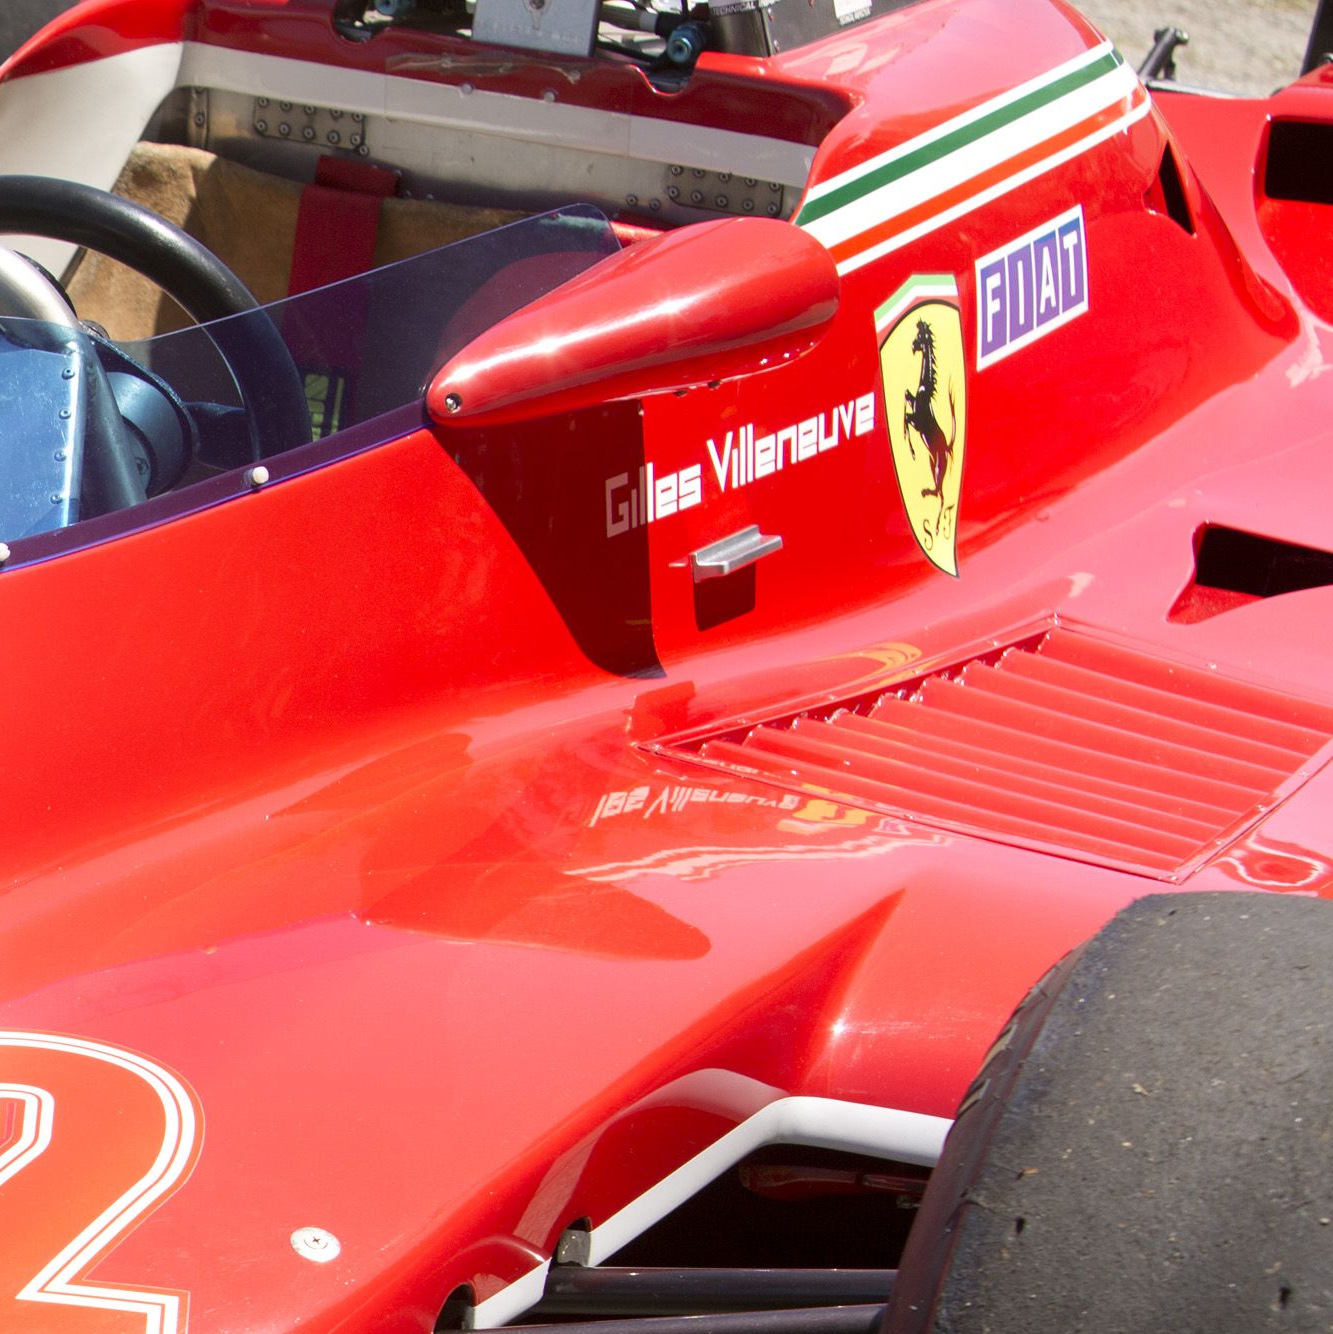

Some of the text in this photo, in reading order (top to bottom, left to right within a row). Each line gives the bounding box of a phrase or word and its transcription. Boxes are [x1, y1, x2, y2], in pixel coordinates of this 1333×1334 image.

[986, 230, 1078, 343] FIAT
[605, 391, 875, 538] Gilles Villeneuve
[922, 518, 934, 551] S
